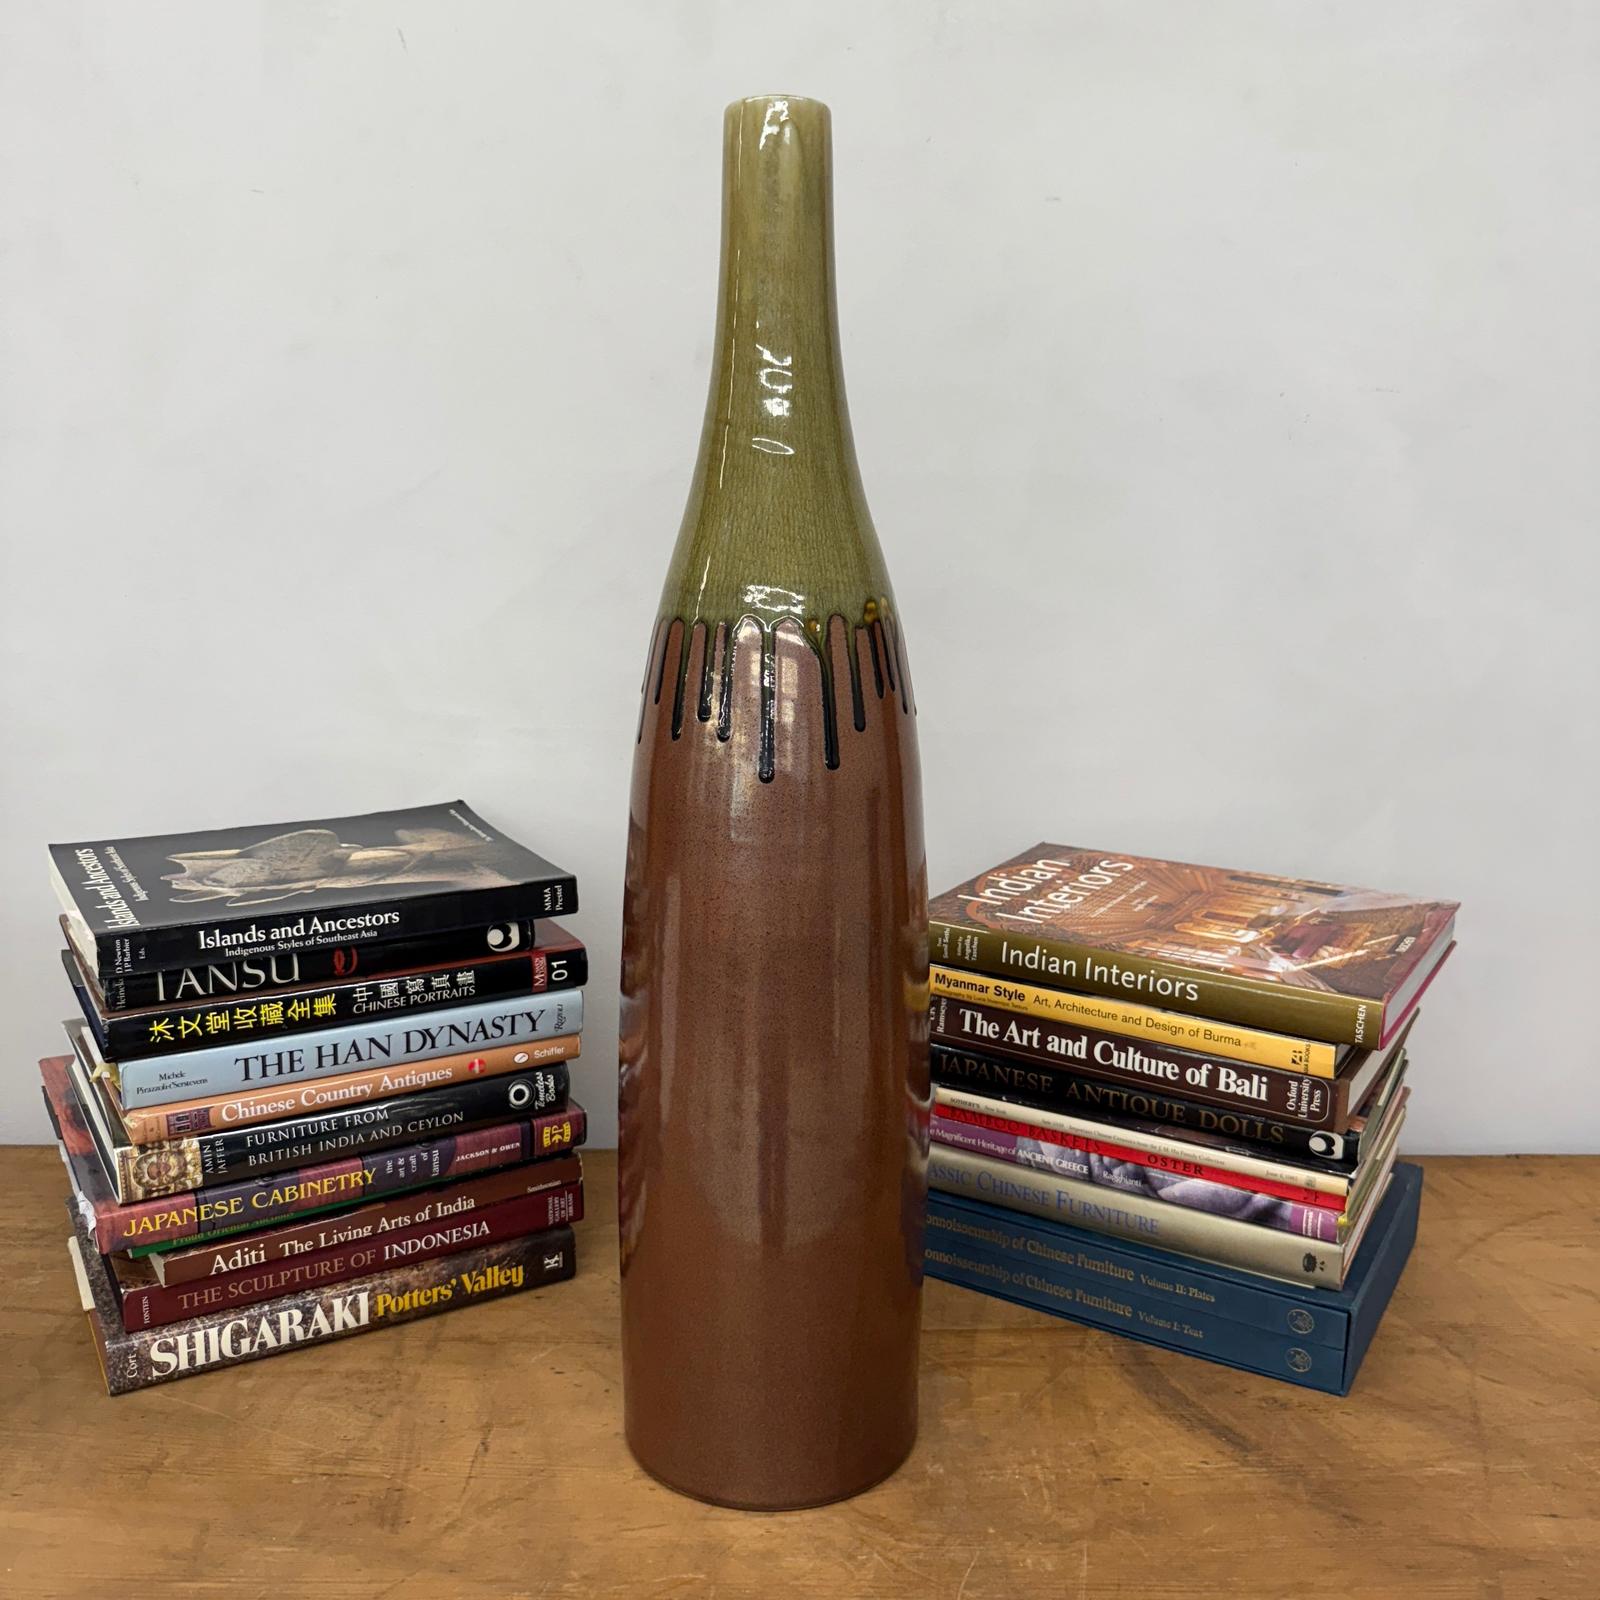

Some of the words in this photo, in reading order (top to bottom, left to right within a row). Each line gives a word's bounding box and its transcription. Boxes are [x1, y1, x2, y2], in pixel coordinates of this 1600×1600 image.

[75, 848, 113, 884] Ancestors
[957, 858, 1072, 905] Indian
[84, 884, 122, 899] and
[555, 885, 563, 910] Prestel
[995, 859, 1135, 923] Interiors
[95, 900, 140, 928] Islands
[199, 925, 265, 949] Islands
[271, 919, 305, 940] and
[310, 911, 400, 934] Ancestors
[115, 939, 123, 965] Newton
[123, 939, 131, 962] Barbier
[225, 944, 275, 957] Indigenous
[278, 937, 304, 951] Styles
[306, 936, 315, 946] of
[316, 931, 358, 945] Southeast
[360, 929, 377, 939] Asia
[551, 960, 568, 981] 01
[1001, 941, 1076, 977] Indian
[1085, 957, 1198, 1001] Interiors
[353, 997, 407, 1014] CHINESE
[410, 985, 475, 1006] PORTRAITS
[935, 973, 990, 994] Myanmar
[993, 985, 1026, 1001] Style
[1033, 994, 1051, 1008] Art,
[1054, 998, 1118, 1022] Architecture
[1121, 1012, 1142, 1027] and
[1145, 1017, 1184, 1037] Design
[1188, 1027, 1200, 1039] of
[1203, 1029, 1241, 1047] Burma
[936, 998, 947, 1033] Ramseyer
[1355, 1004, 1366, 1043] TASCHEN
[235, 1049, 305, 1082] THE
[315, 1034, 391, 1069] HAN
[403, 1009, 546, 1055] DYNASTY
[534, 1047, 565, 1059] Schiffer
[959, 1008, 1000, 1039] The
[1003, 1019, 1041, 1049] Art
[1046, 1034, 1087, 1059] and
[1094, 1040, 1180, 1080] Culture
[1185, 1063, 1212, 1088] of
[1217, 1066, 1268, 1100] Bali
[221, 1097, 295, 1122] Chinese
[301, 1080, 372, 1107] Country
[379, 1067, 452, 1092] Antiques
[940, 1053, 1054, 1093] JAPANESE
[1067, 1081, 1185, 1125] ANTIQUE
[1200, 1103, 1285, 1143] DOLLS
[1286, 1080, 1298, 1111] Oxford
[1298, 1078, 1312, 1118] University
[1310, 1089, 1321, 1112] Press
[246, 1120, 338, 1148] FURNITURE
[345, 1111, 389, 1128] FROM
[248, 1140, 312, 1167] BRITISH
[319, 1133, 365, 1151] INDIA
[369, 1125, 403, 1143] AND
[408, 1112, 464, 1133] CEYLON
[201, 1144, 214, 1174] AMIN
[213, 1138, 227, 1174] JAFFER
[386, 1159, 394, 1174] the
[421, 1151, 428, 1161] of
[431, 1150, 440, 1176] tansu
[456, 1149, 489, 1162] JACKSON
[491, 1147, 498, 1155] &
[499, 1142, 521, 1153] OWEN
[936, 1128, 976, 1146] Magnificent
[978, 1138, 1008, 1155] Heritage
[1008, 1147, 1016, 1155] of
[1017, 1148, 1054, 1168] ANCIENT
[1055, 1157, 1089, 1175] GREECE
[1147, 1154, 1205, 1176] OSTER
[123, 1196, 244, 1238] JAPANESE
[252, 1167, 377, 1209] CABINETRY
[928, 1163, 972, 1185] ASSIC
[976, 1170, 1049, 1207] CHINESE
[1055, 1188, 1160, 1235] FURNITURE
[210, 1243, 266, 1276] Aditi
[279, 1236, 313, 1257] The
[320, 1226, 372, 1248] Living
[377, 1210, 411, 1234] Arts
[415, 1205, 432, 1222] of
[436, 1195, 475, 1217] India
[178, 1288, 222, 1310] THE
[228, 1258, 346, 1298] SCULPTURE
[351, 1249, 376, 1269] OF
[384, 1220, 490, 1261] INDONESIA
[926, 1214, 1010, 1248] onnoisseurship
[1012, 1237, 1027, 1250] of
[1027, 1240, 1074, 1265] Chinese
[1077, 1254, 1134, 1281] Furniture
[1140, 1273, 1173, 1292] Volume
[1188, 1286, 1216, 1303] Plates
[924, 1248, 1010, 1283] onnoisseurship
[1012, 1272, 1026, 1285] of
[1026, 1274, 1073, 1300] Chinese
[1076, 1290, 1132, 1317] Furniture
[1138, 1311, 1171, 1329] Volume
[150, 1291, 370, 1378] SHIGARAKI
[377, 1278, 457, 1318] Potters'
[461, 1264, 524, 1295] Valley
[126, 1352, 137, 1378] Cort
